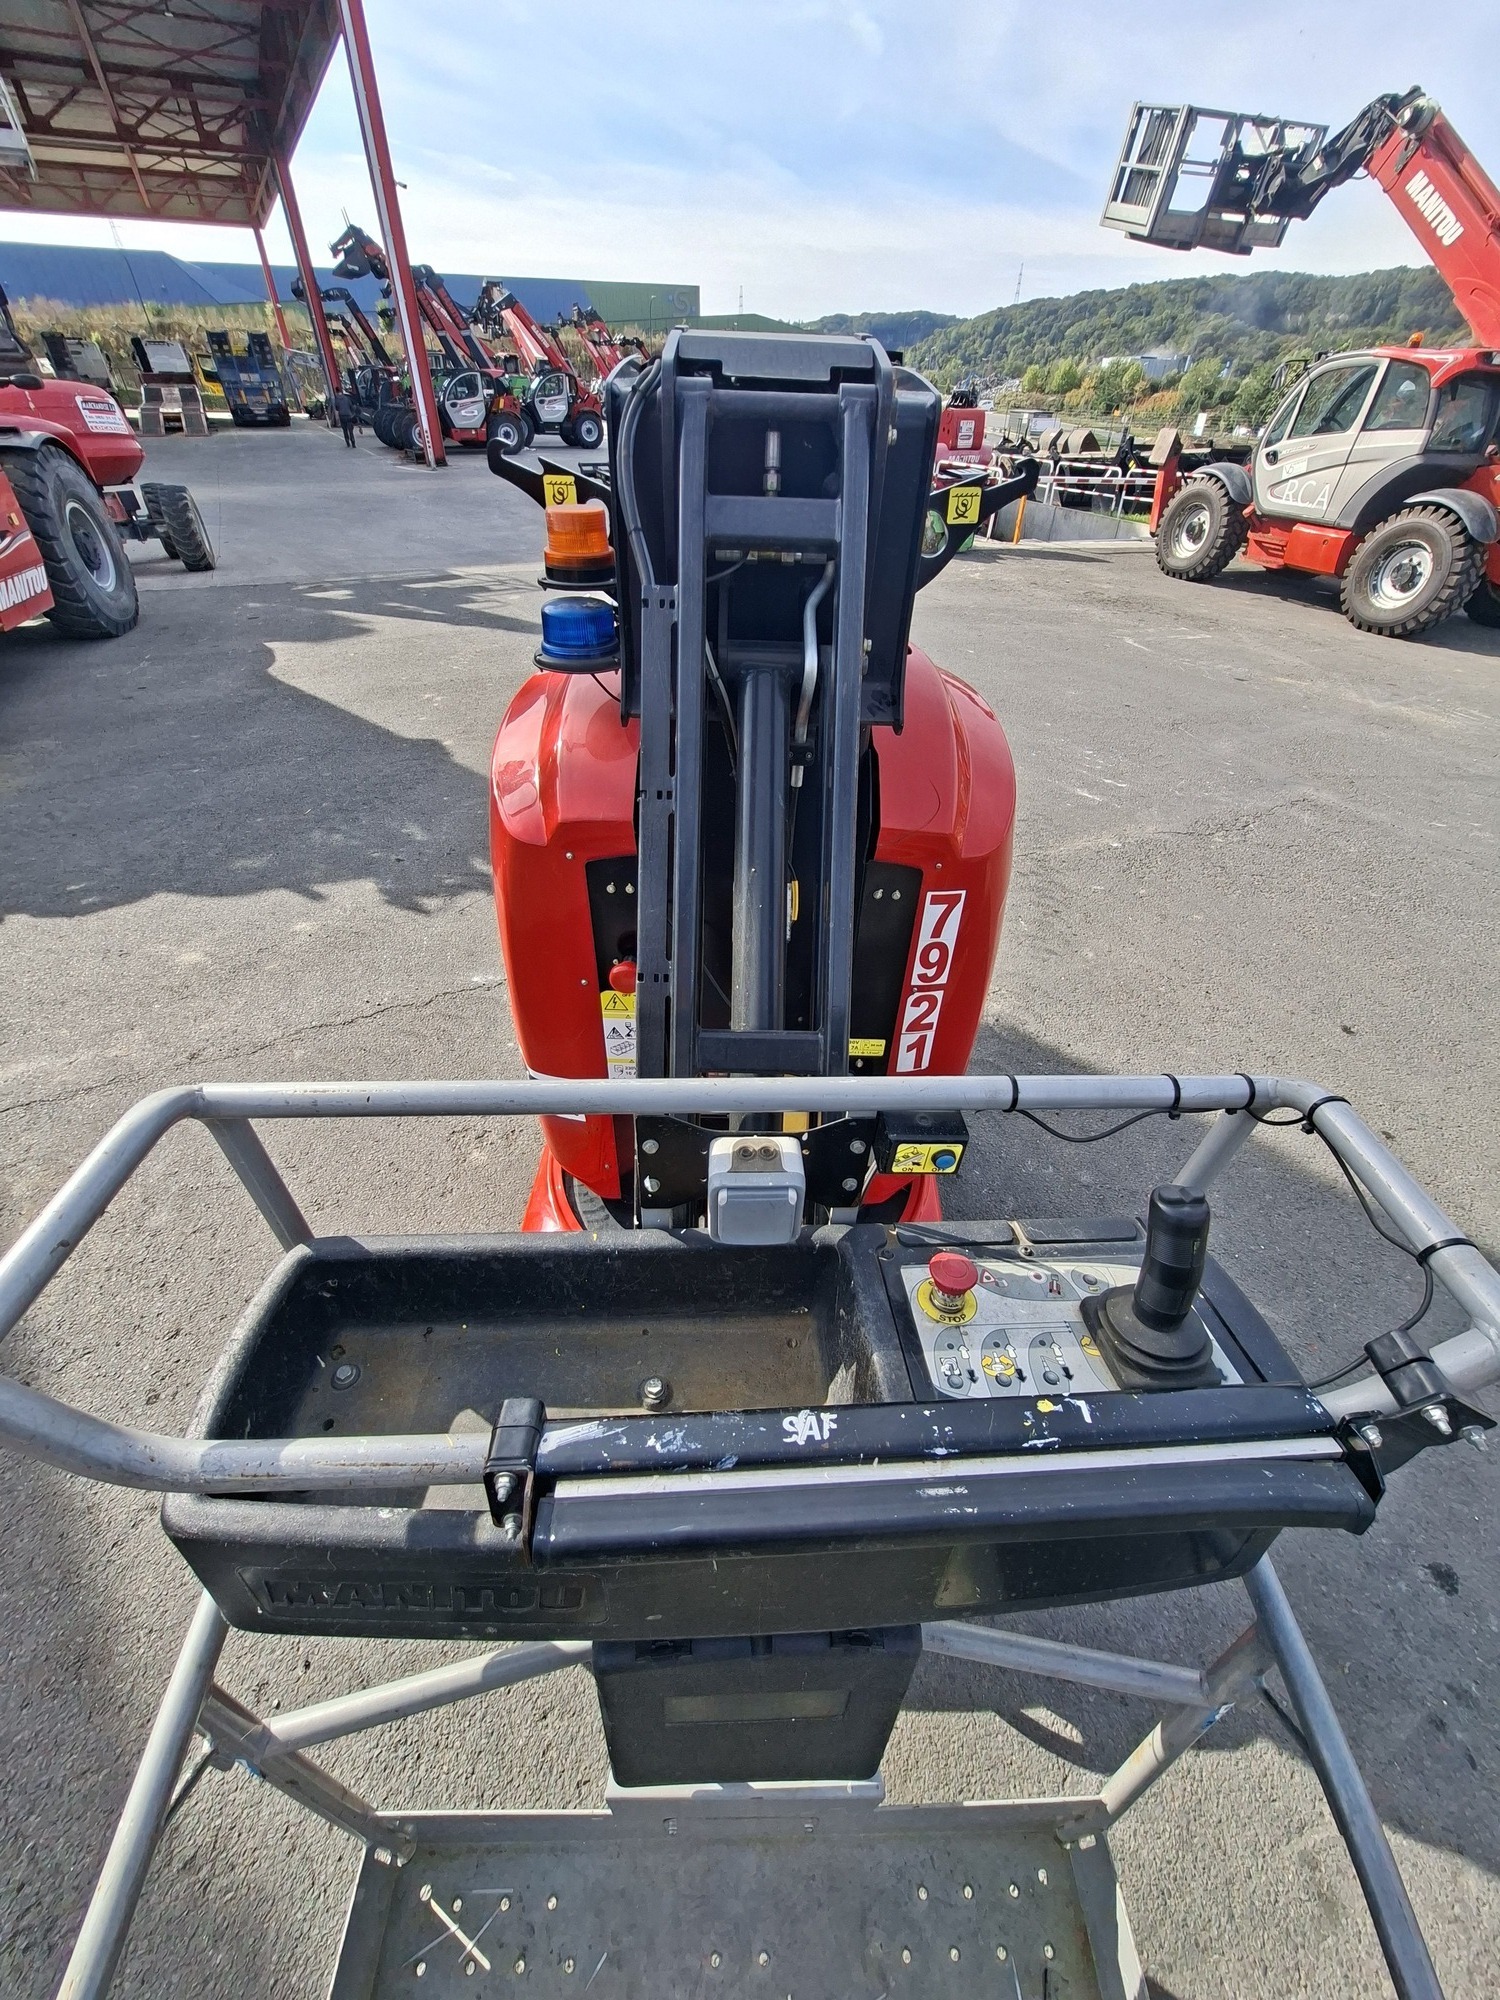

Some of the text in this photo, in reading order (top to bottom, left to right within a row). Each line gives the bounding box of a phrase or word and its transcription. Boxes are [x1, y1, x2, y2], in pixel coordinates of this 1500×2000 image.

[1405, 169, 1465, 246] MANITOU
[0, 565, 48, 612] MANITOU
[905, 893, 962, 1070] 7921
[938, 1313, 967, 1323] STOP
[264, 1580, 586, 1613] MANITOU
